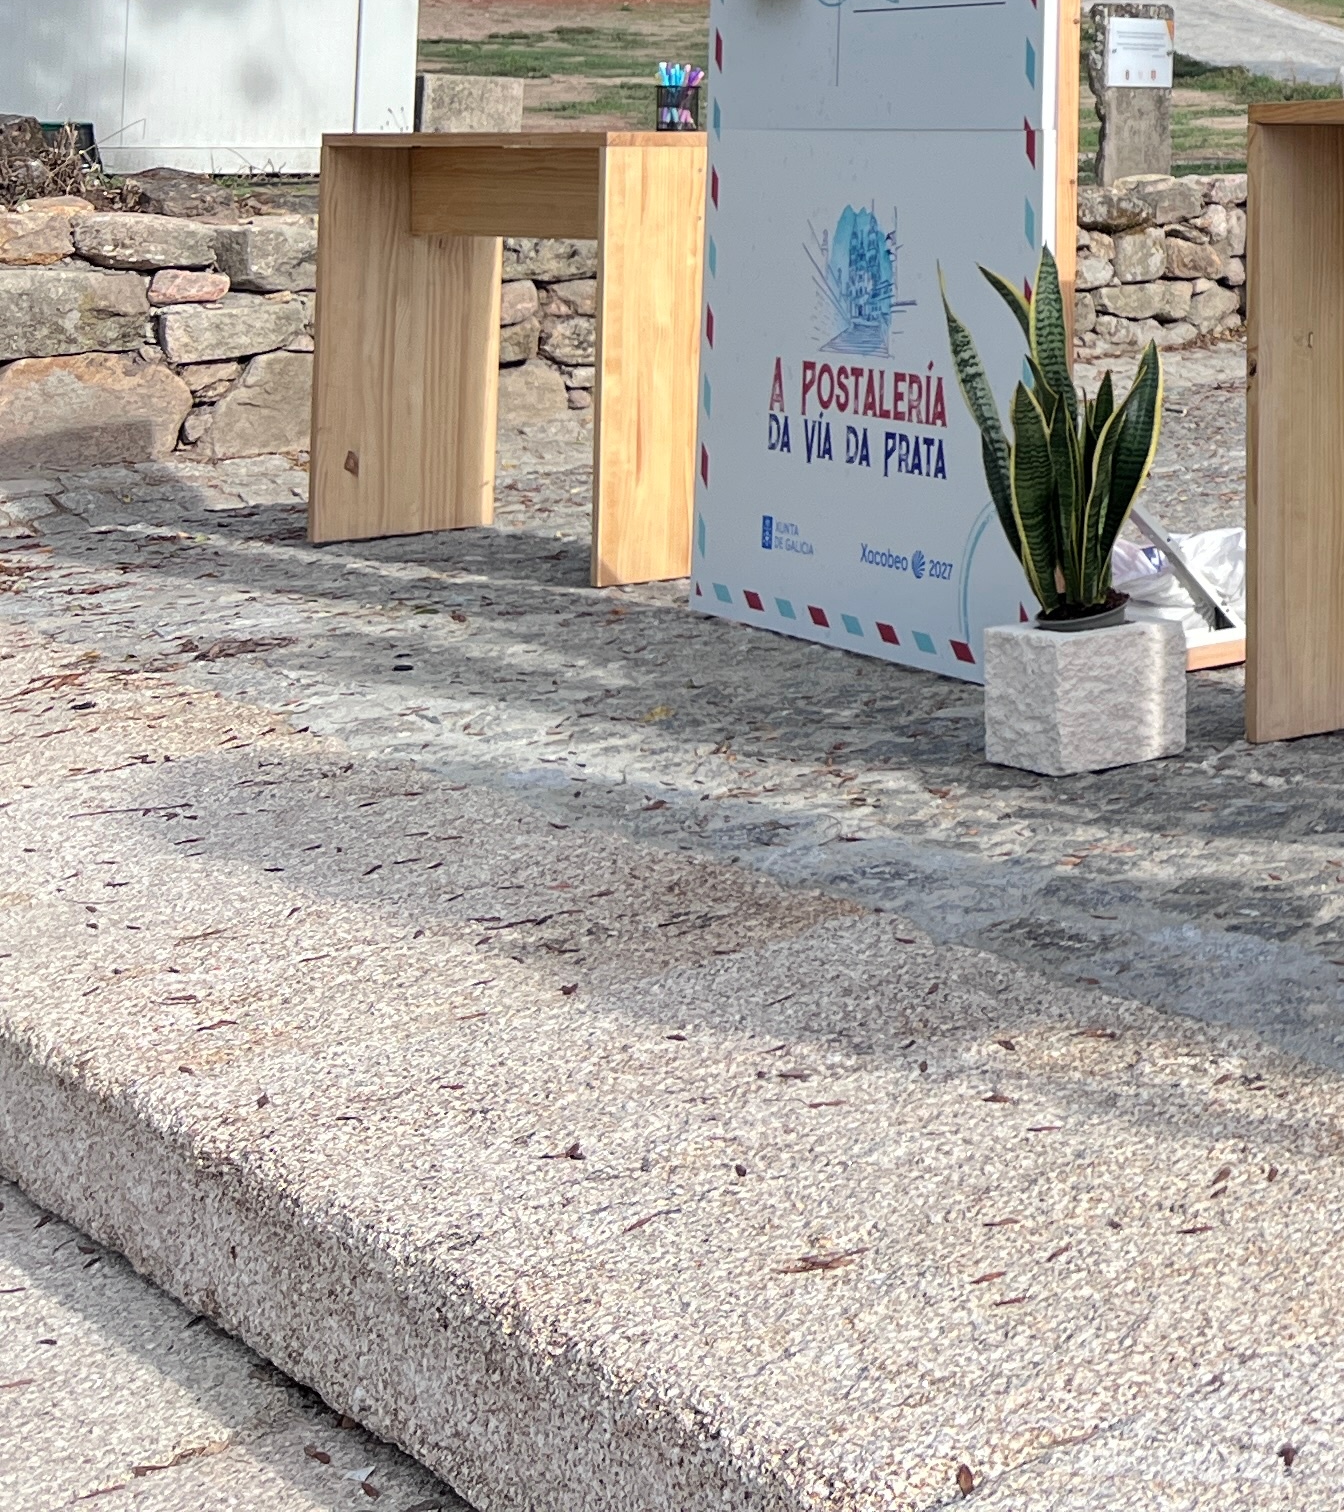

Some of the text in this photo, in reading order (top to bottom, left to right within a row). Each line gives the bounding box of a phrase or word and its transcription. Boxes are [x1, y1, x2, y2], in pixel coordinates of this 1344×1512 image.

[769, 356, 948, 429] A POSTALERÍA
[768, 410, 948, 481] DA VÍA DA PRATA
[774, 521, 800, 536] XUNTA
[774, 536, 814, 556] DE GALICIA
[860, 542, 954, 581] Xacobeo 2027
